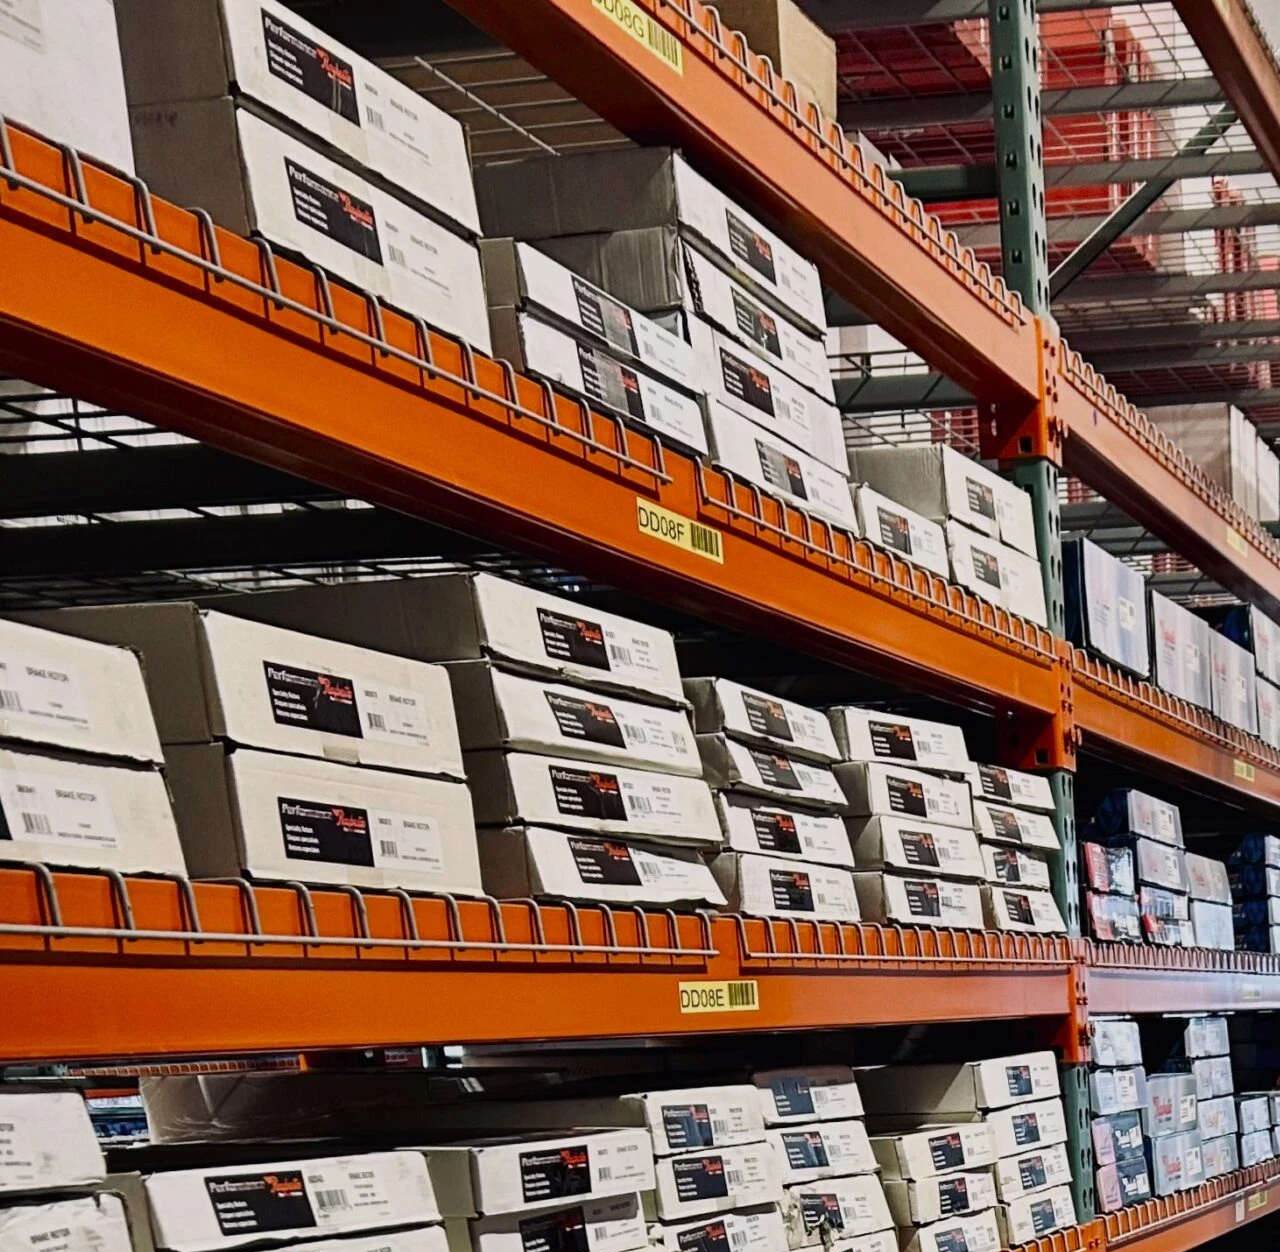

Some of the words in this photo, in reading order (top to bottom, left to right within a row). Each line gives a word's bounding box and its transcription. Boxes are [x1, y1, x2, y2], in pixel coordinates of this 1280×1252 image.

[594, 0, 644, 38] D08G
[638, 506, 684, 541] DD08F
[26, 666, 49, 680] BRAKE
[48, 671, 70, 683] ROTOR
[55, 789, 78, 800] BRAKE
[77, 792, 97, 803] ROTOR
[680, 989, 725, 1008] DD08E
